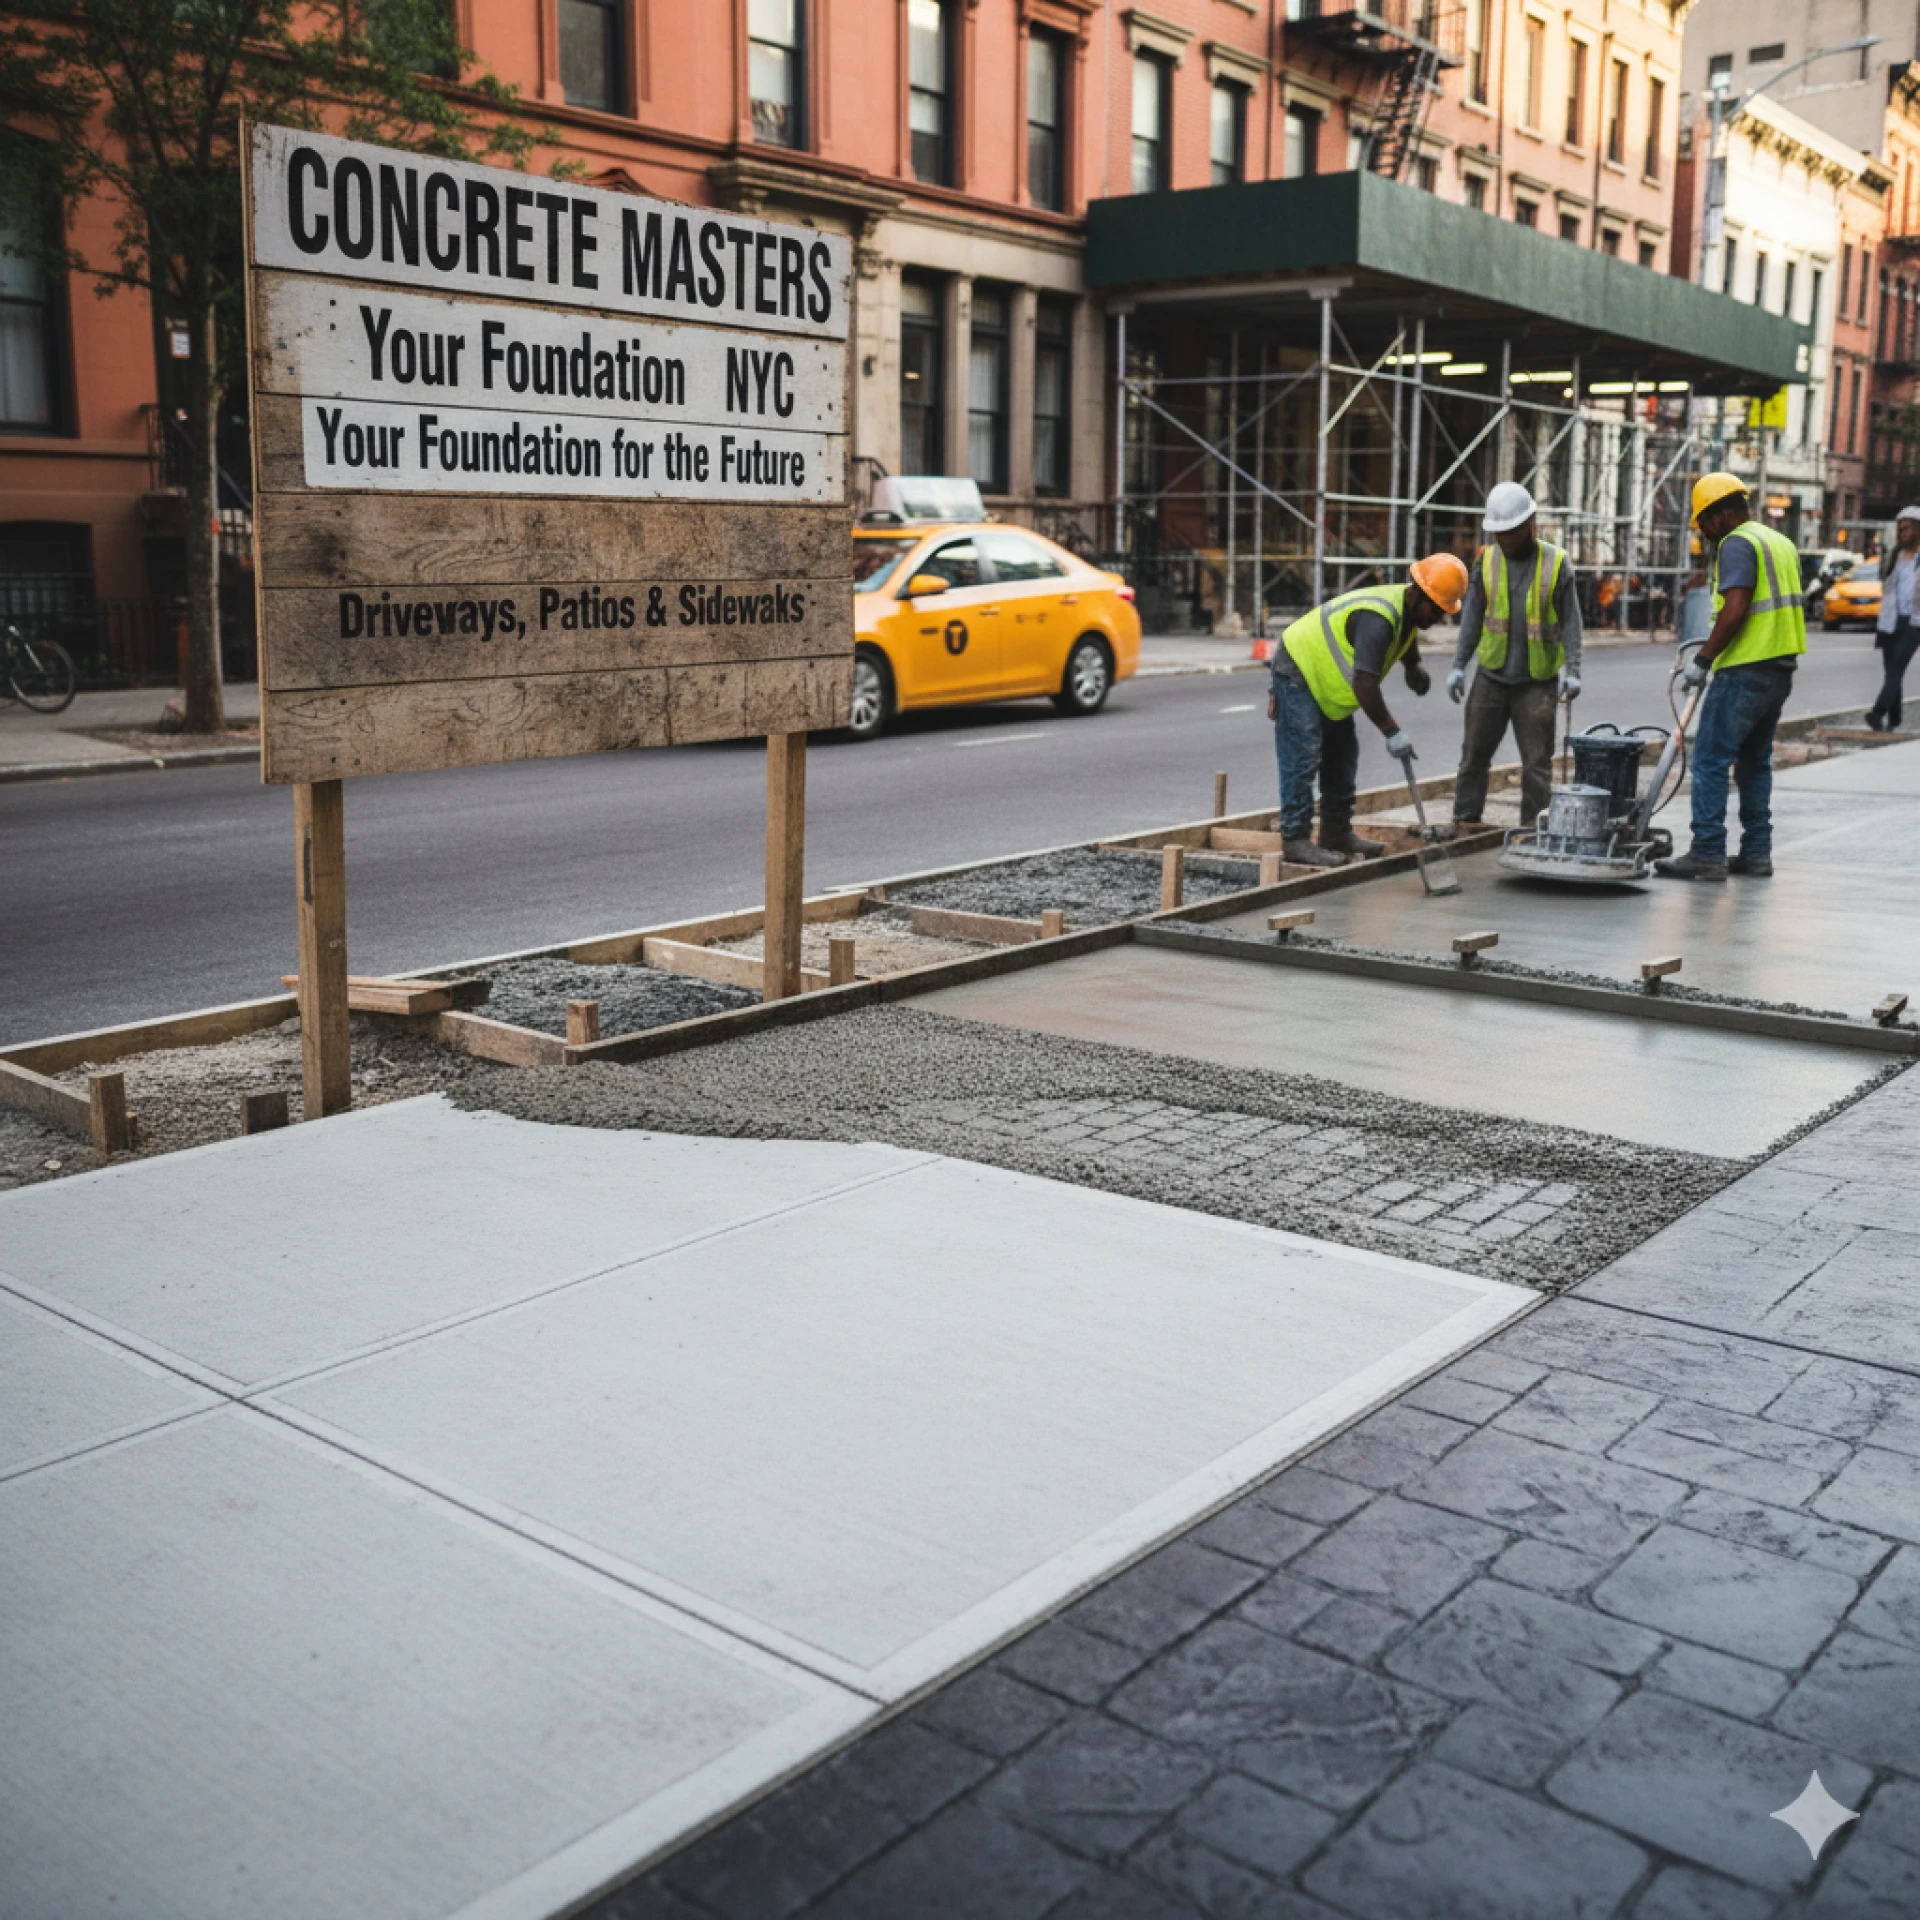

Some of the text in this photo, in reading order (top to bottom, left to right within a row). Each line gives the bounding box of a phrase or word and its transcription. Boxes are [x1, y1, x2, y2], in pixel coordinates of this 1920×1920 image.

[287, 147, 832, 324] CONCRETE MASTERS
[359, 305, 794, 418] Your Foundation NYC
[316, 406, 805, 487] Your Foundation for the Future
[539, 584, 636, 630] Patios
[646, 585, 667, 627] &
[678, 584, 804, 626] Sidewaks
